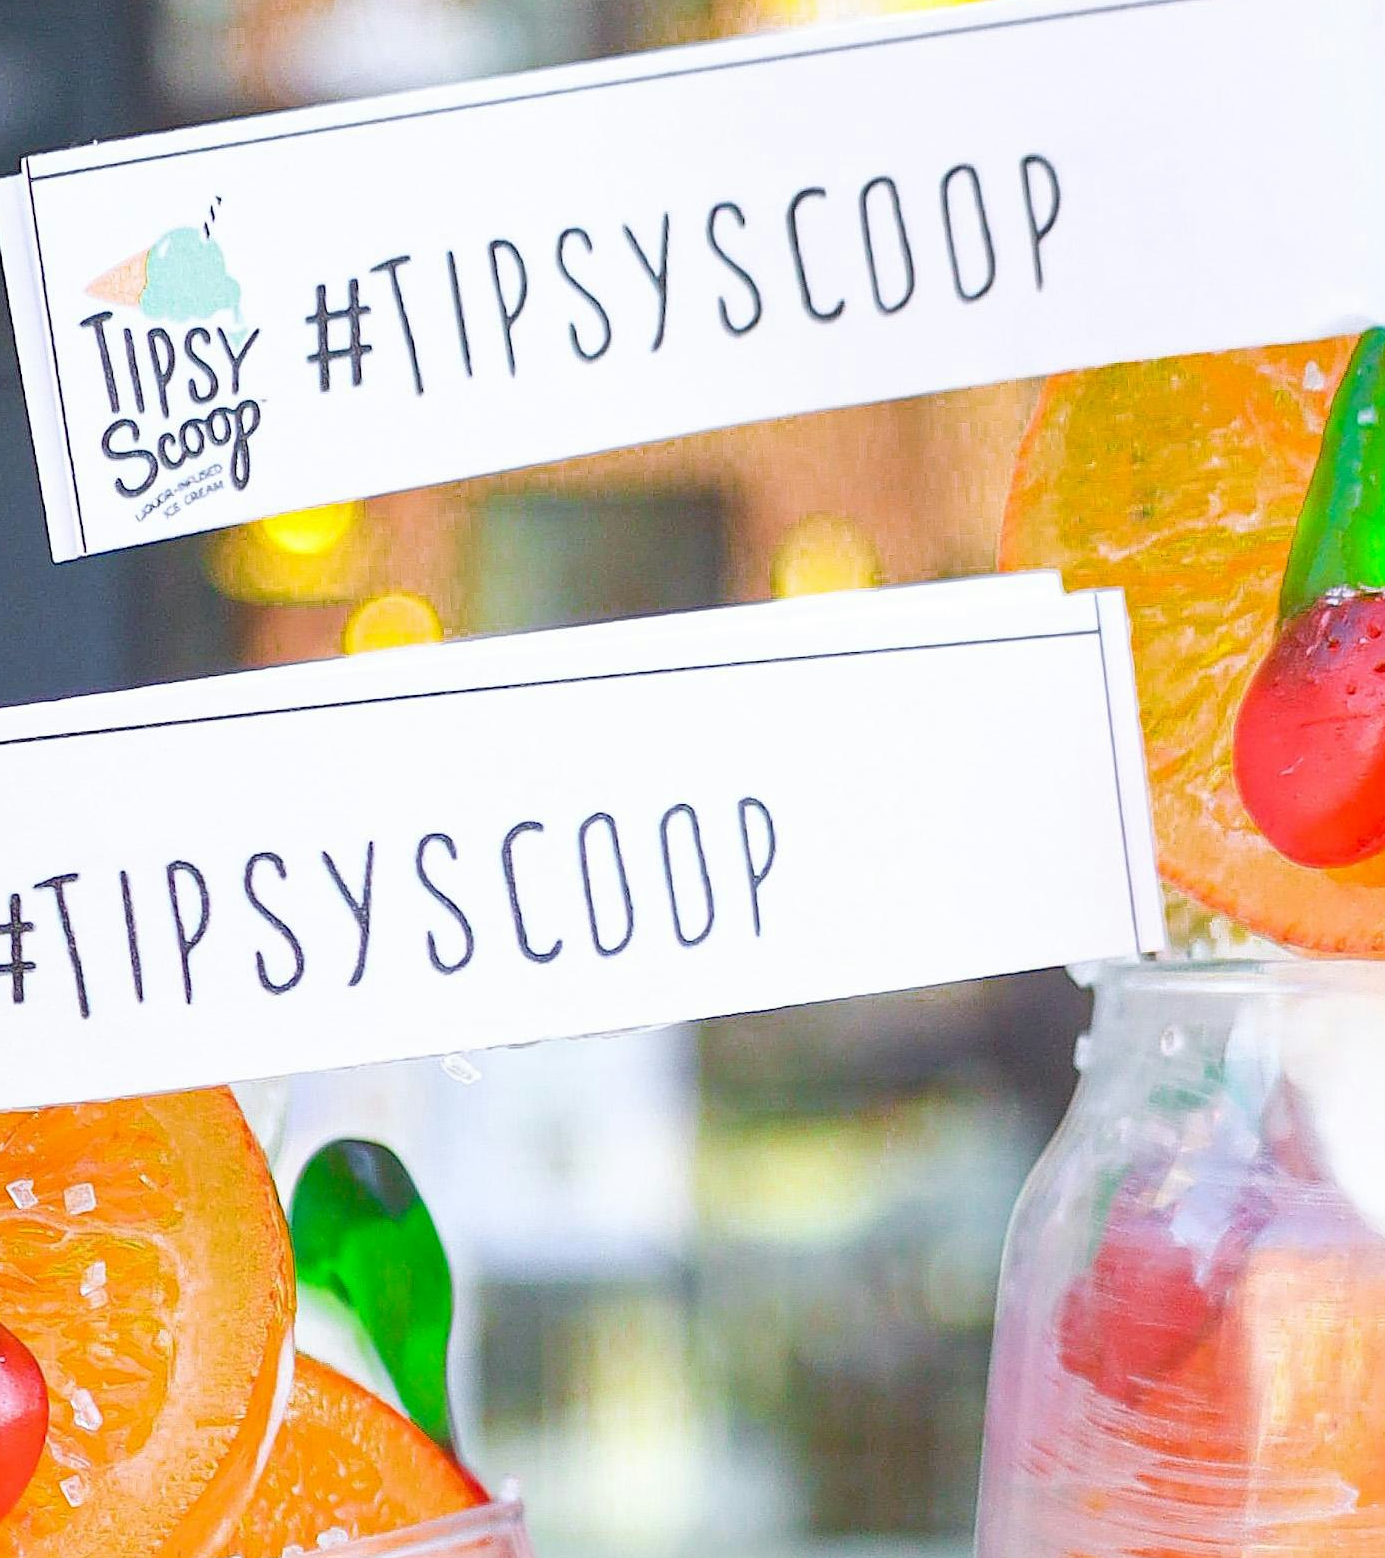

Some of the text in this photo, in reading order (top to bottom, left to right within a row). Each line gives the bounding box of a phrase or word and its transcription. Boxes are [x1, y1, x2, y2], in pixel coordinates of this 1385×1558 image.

[304, 152, 1063, 398] #TIPSYSCOOP
[79, 310, 260, 419] TIPSY
[101, 399, 261, 498] Scoop
